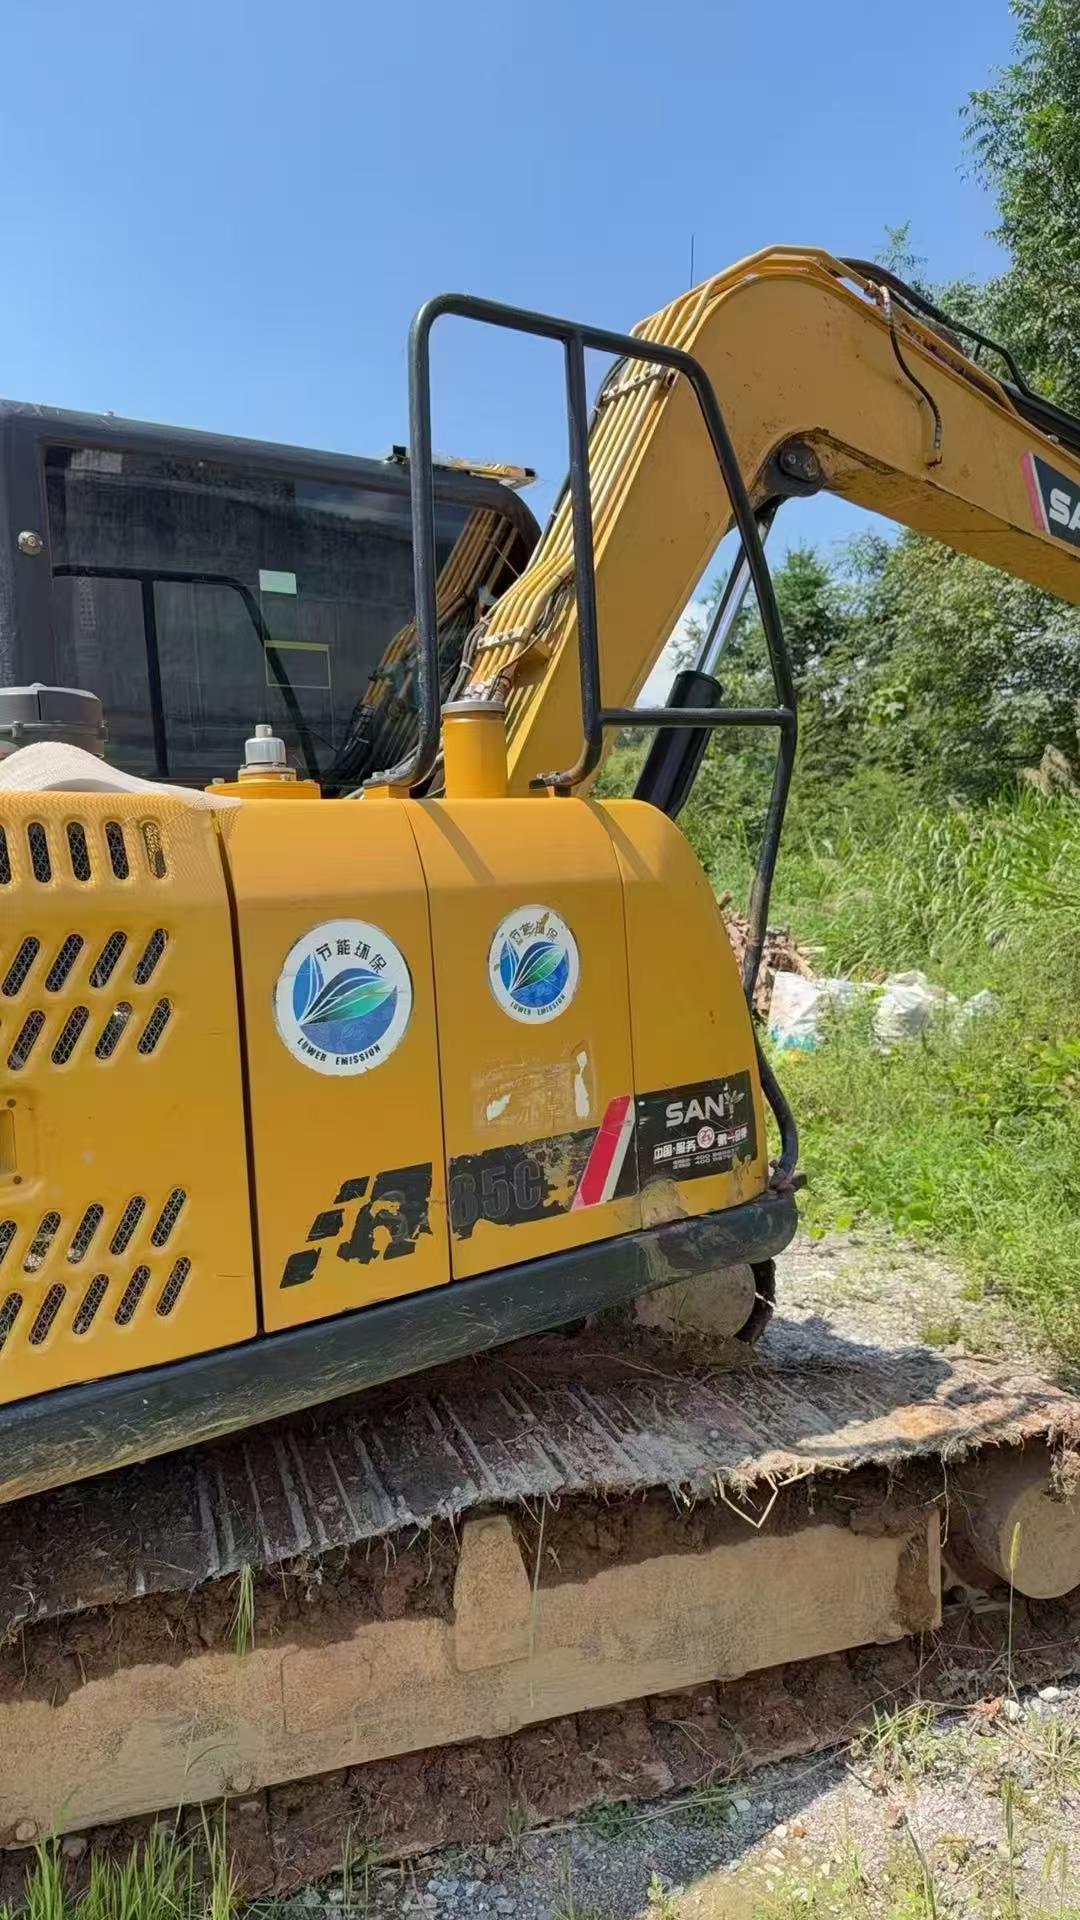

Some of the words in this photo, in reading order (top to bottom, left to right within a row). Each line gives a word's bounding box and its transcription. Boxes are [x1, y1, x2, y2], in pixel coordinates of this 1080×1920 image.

[316, 939, 387, 973] 节能环保
[297, 1038, 327, 1061] LOWER
[336, 1044, 381, 1065] EMISSION
[666, 1090, 744, 1127] SANY
